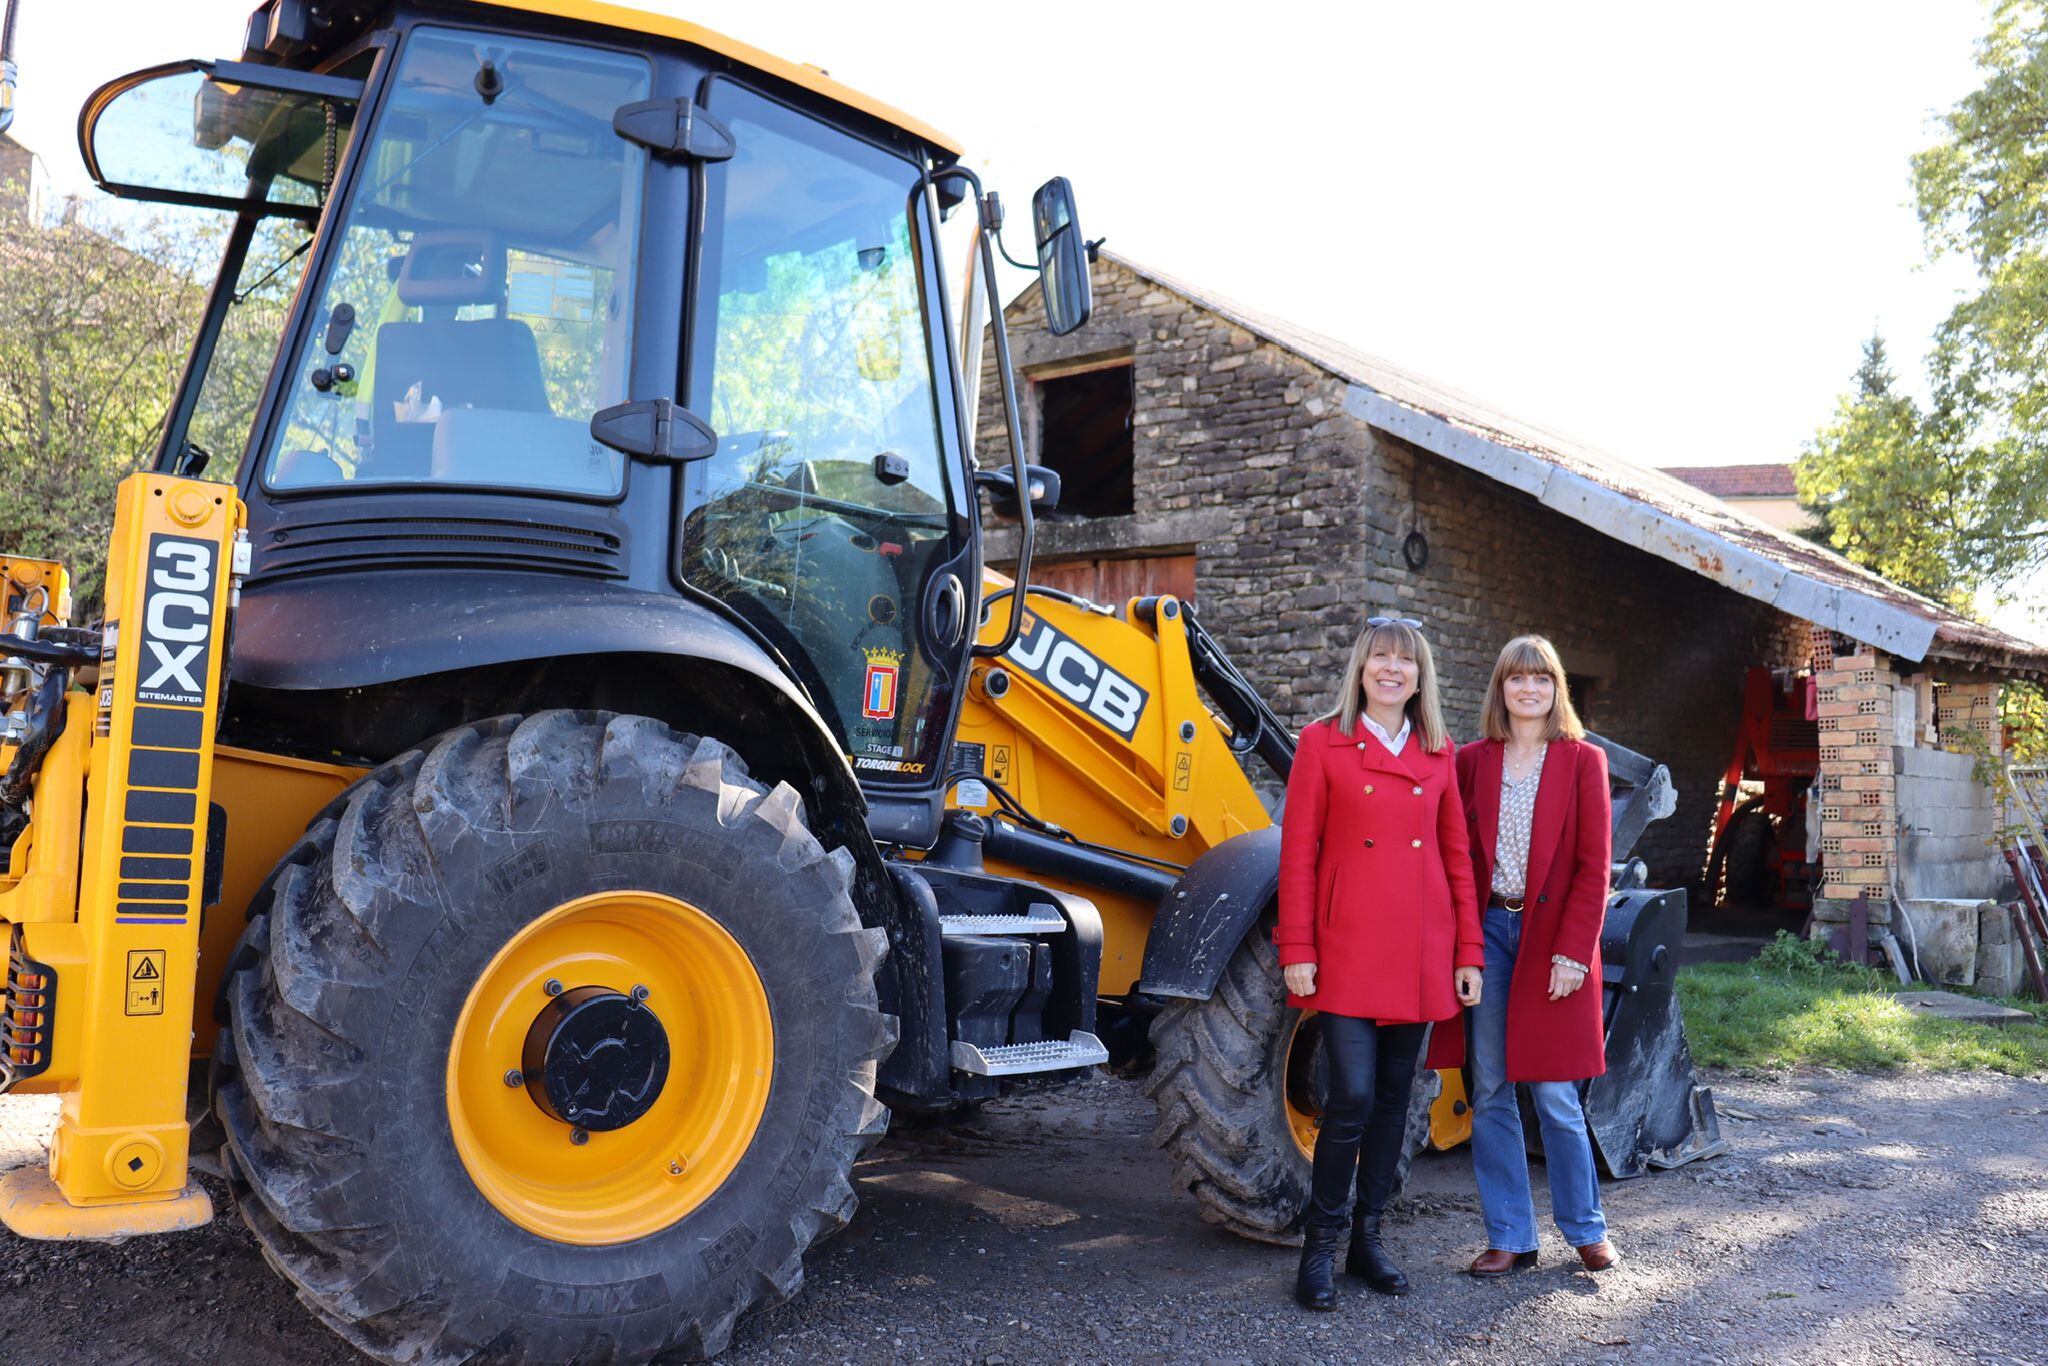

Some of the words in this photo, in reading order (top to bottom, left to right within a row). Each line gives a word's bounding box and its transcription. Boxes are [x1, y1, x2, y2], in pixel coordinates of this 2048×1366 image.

[140, 541, 211, 692] 3CX
[1008, 626, 1142, 732] JCB
[139, 692, 202, 703] SITEMASTER
[867, 744, 893, 755] STAGE
[855, 758, 926, 773] TORQUELOCK
